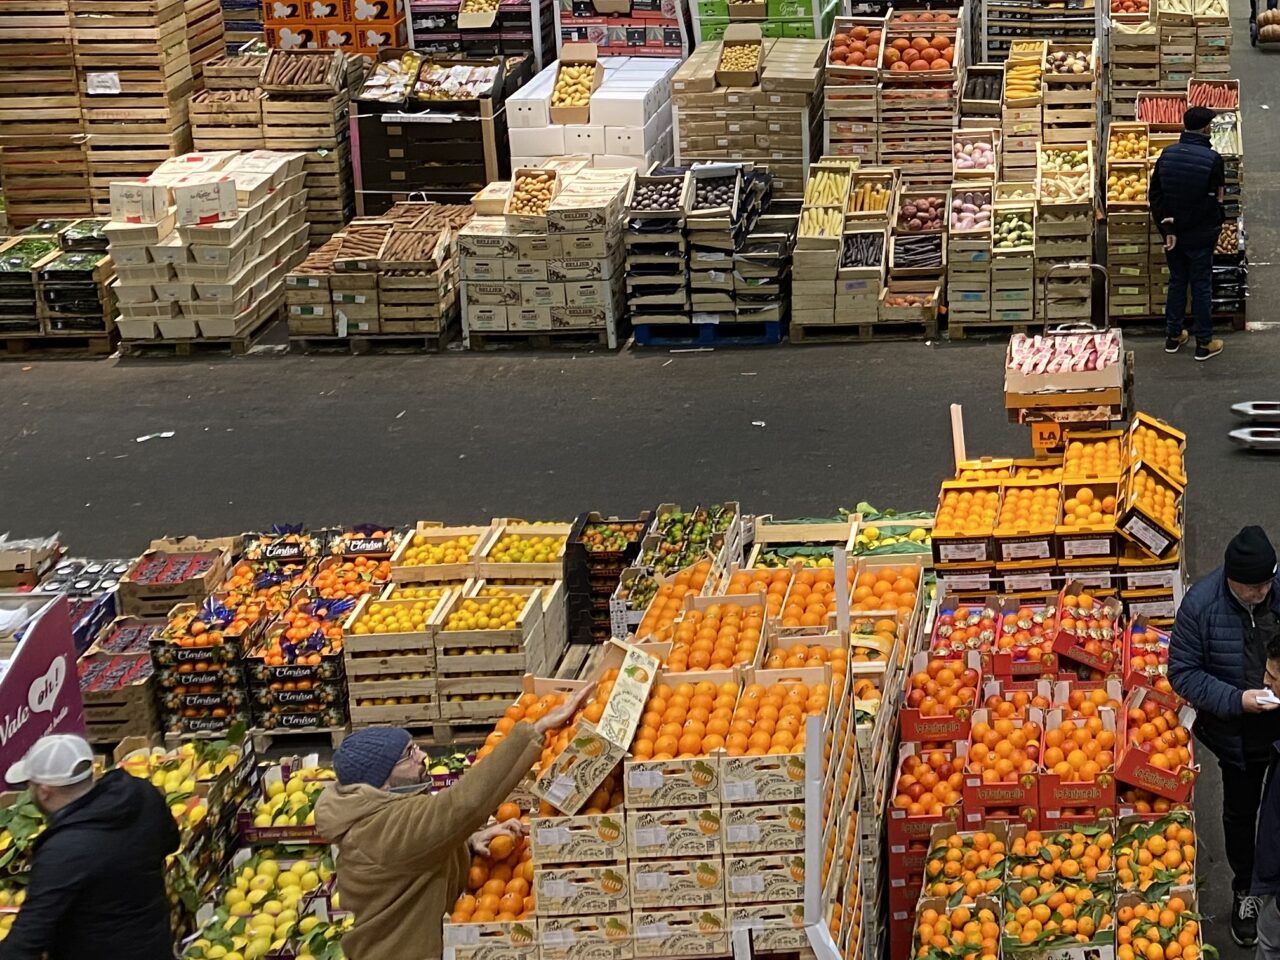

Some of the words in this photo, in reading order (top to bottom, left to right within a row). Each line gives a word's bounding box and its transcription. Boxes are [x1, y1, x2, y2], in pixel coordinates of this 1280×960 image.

[286, 3, 300, 18] 2
[325, 3, 338, 18] 2
[373, 1, 390, 20] 2
[297, 29, 314, 48] 2
[340, 32, 353, 46] 2
[378, 32, 391, 46] 2
[1039, 431, 1057, 440] LA
[266, 545, 299, 557] Clarissa
[350, 539, 383, 551] Clarissa
[178, 651, 212, 660] Clarissa
[276, 667, 310, 677] Clarissa
[181, 675, 216, 684] Clarissa
[37, 667, 59, 705] oh!
[186, 696, 221, 706] Clarissa
[279, 692, 313, 702] Clarissa
[189, 720, 224, 730] Clarissa
[282, 716, 316, 726] Clarissa
